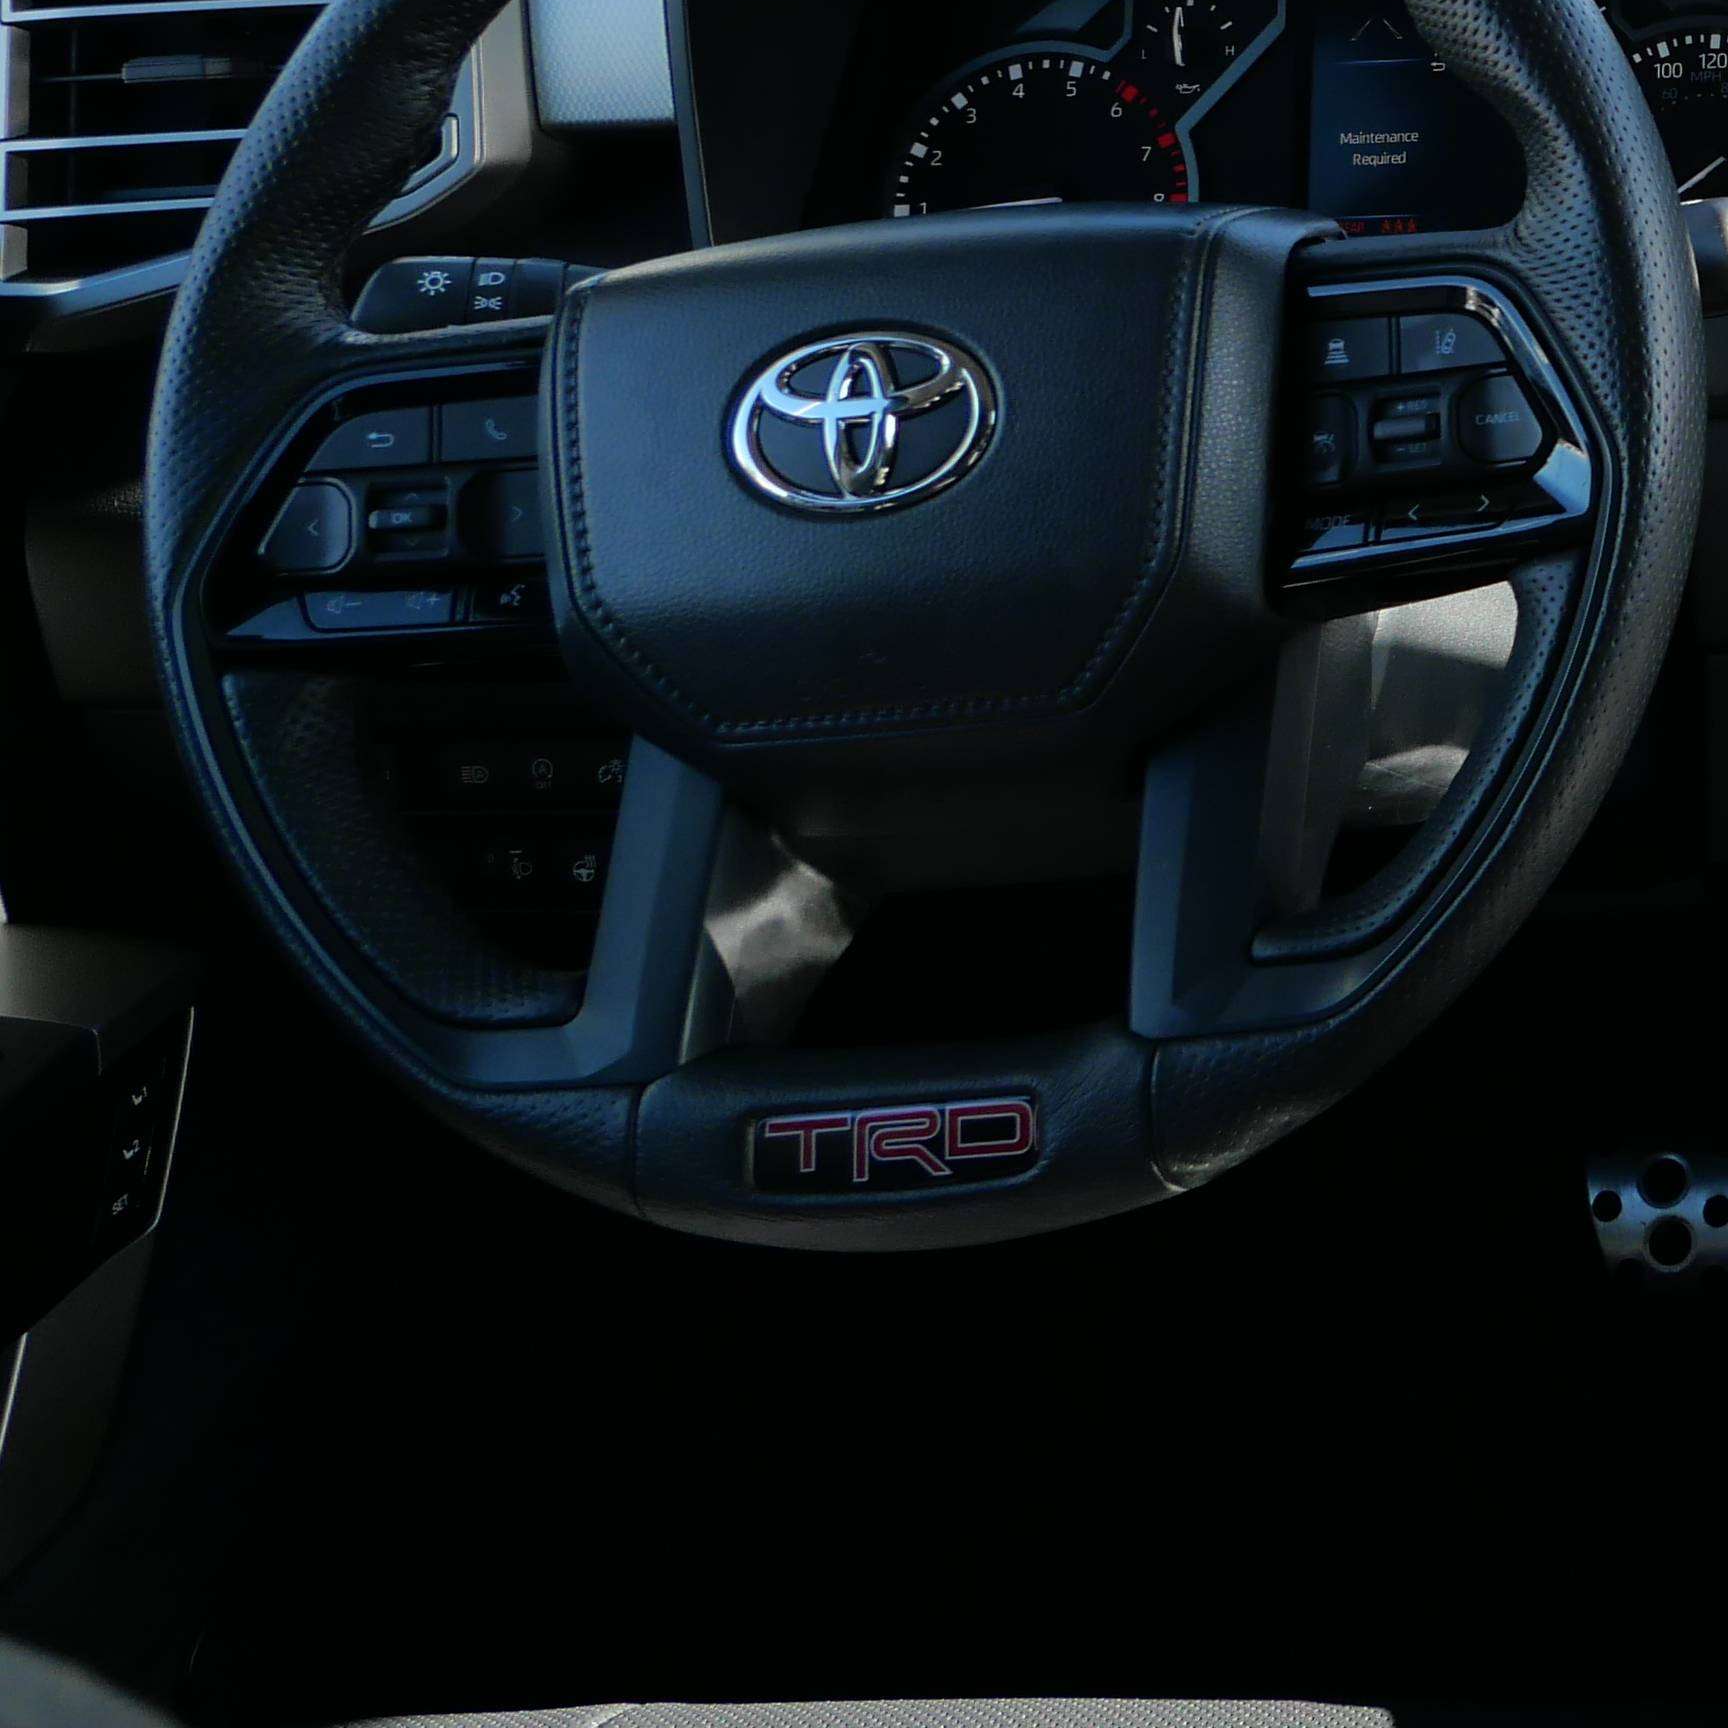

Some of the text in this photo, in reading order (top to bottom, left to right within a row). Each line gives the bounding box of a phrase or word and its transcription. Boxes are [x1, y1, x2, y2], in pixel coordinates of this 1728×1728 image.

[1225, 44, 1236, 57] H
[1699, 53, 1728, 69] 120
[1654, 62, 1683, 79] 100
[1690, 71, 1722, 83] MPH
[1011, 81, 1026, 98] 4
[1065, 81, 1078, 97] 5
[966, 107, 979, 125] 3
[1110, 103, 1123, 118] 6
[1339, 128, 1419, 146] Maintenance
[931, 150, 944, 167] 2
[1141, 146, 1152, 162] 7
[1352, 151, 1407, 168] Required
[919, 201, 928, 215] 1
[1476, 412, 1521, 425] CANCEL
[765, 1097, 1035, 1182] TRD
